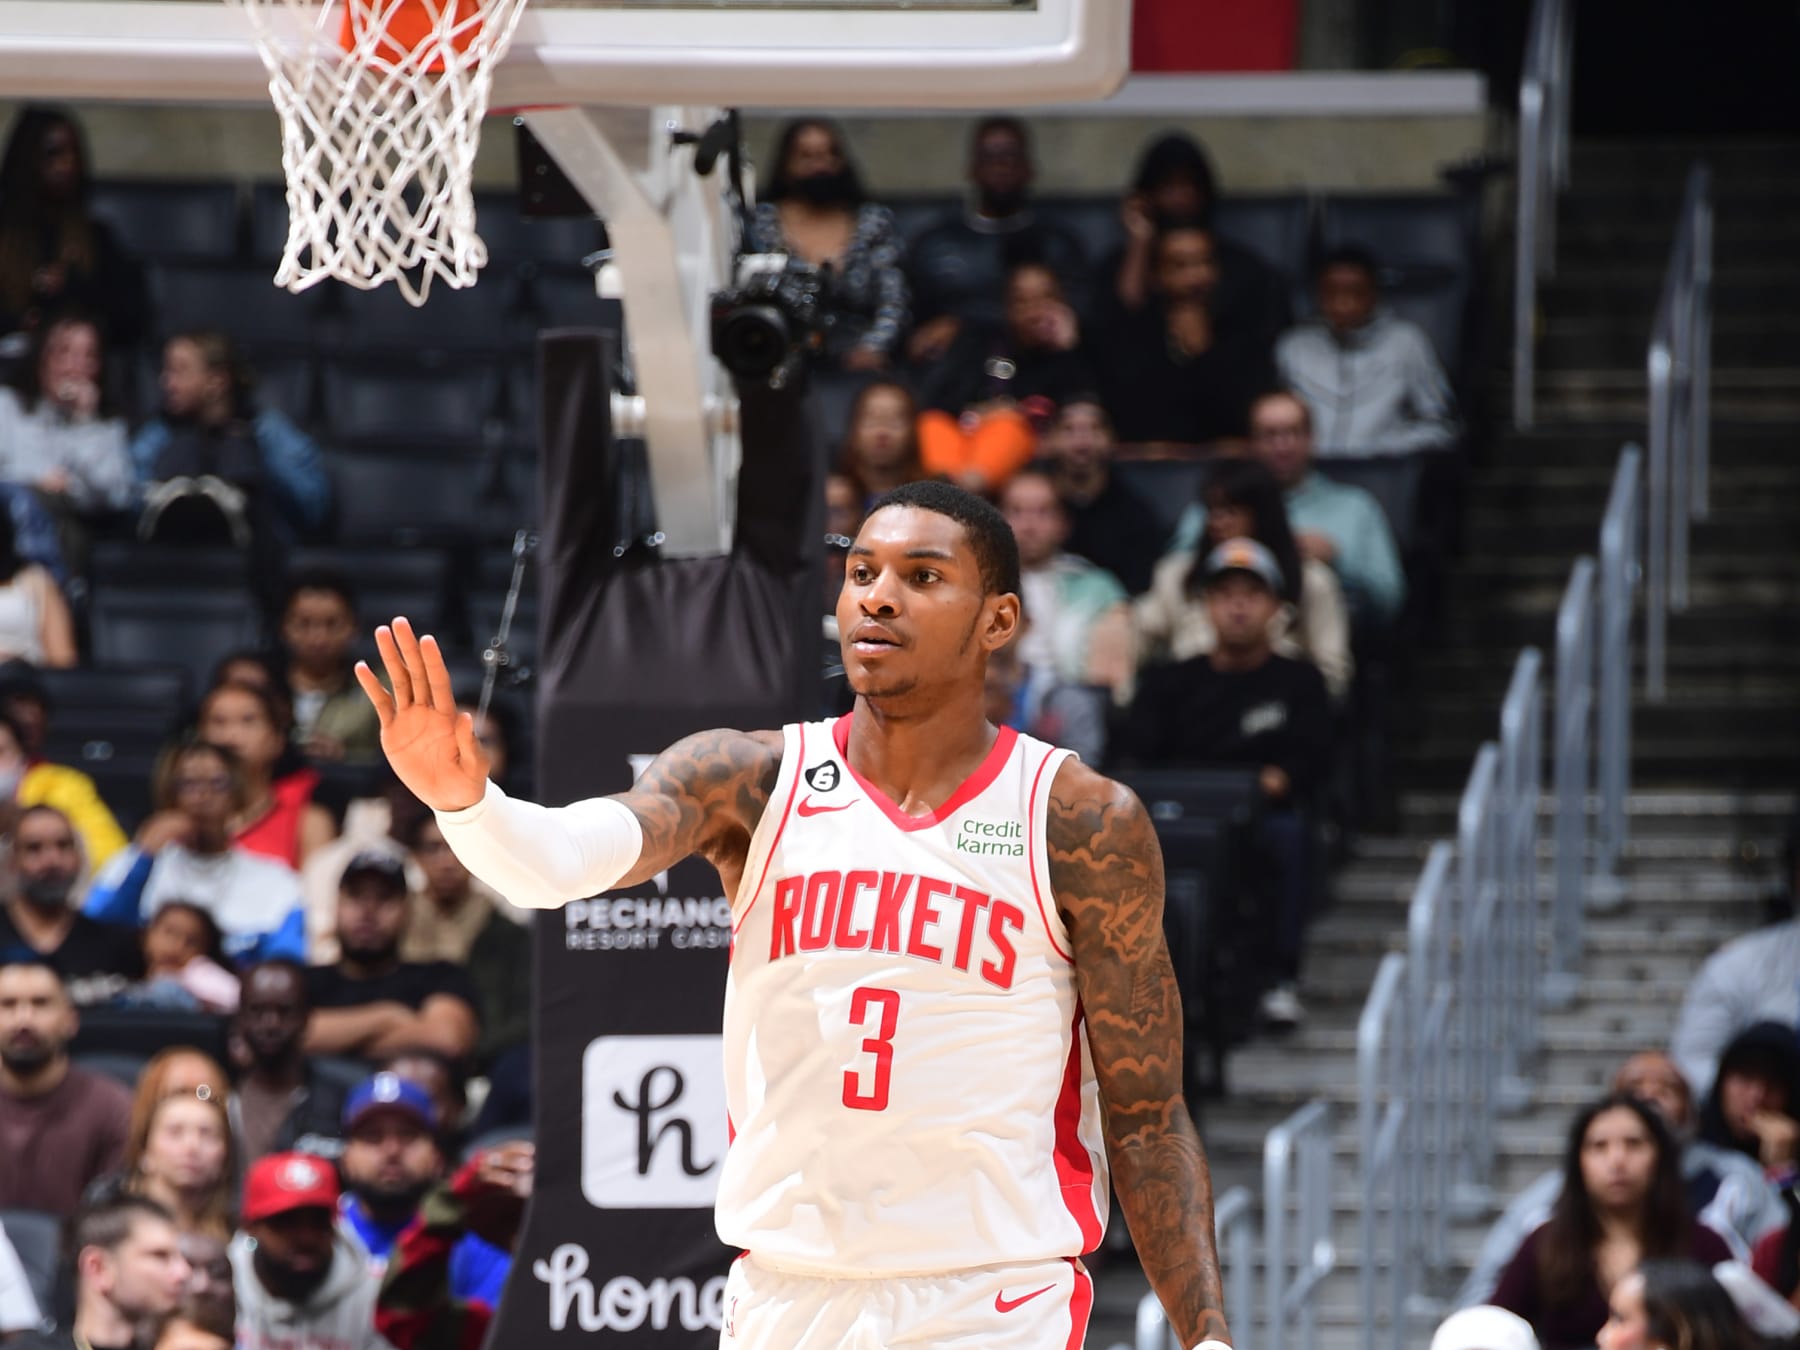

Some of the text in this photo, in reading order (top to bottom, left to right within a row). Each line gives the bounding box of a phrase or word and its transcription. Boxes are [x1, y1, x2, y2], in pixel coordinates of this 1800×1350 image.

[963, 818, 1023, 838] credit
[956, 832, 1025, 857] karma
[565, 928, 660, 950] RESORT
[768, 869, 1025, 991] ROCKETS
[842, 987, 900, 1111] 3
